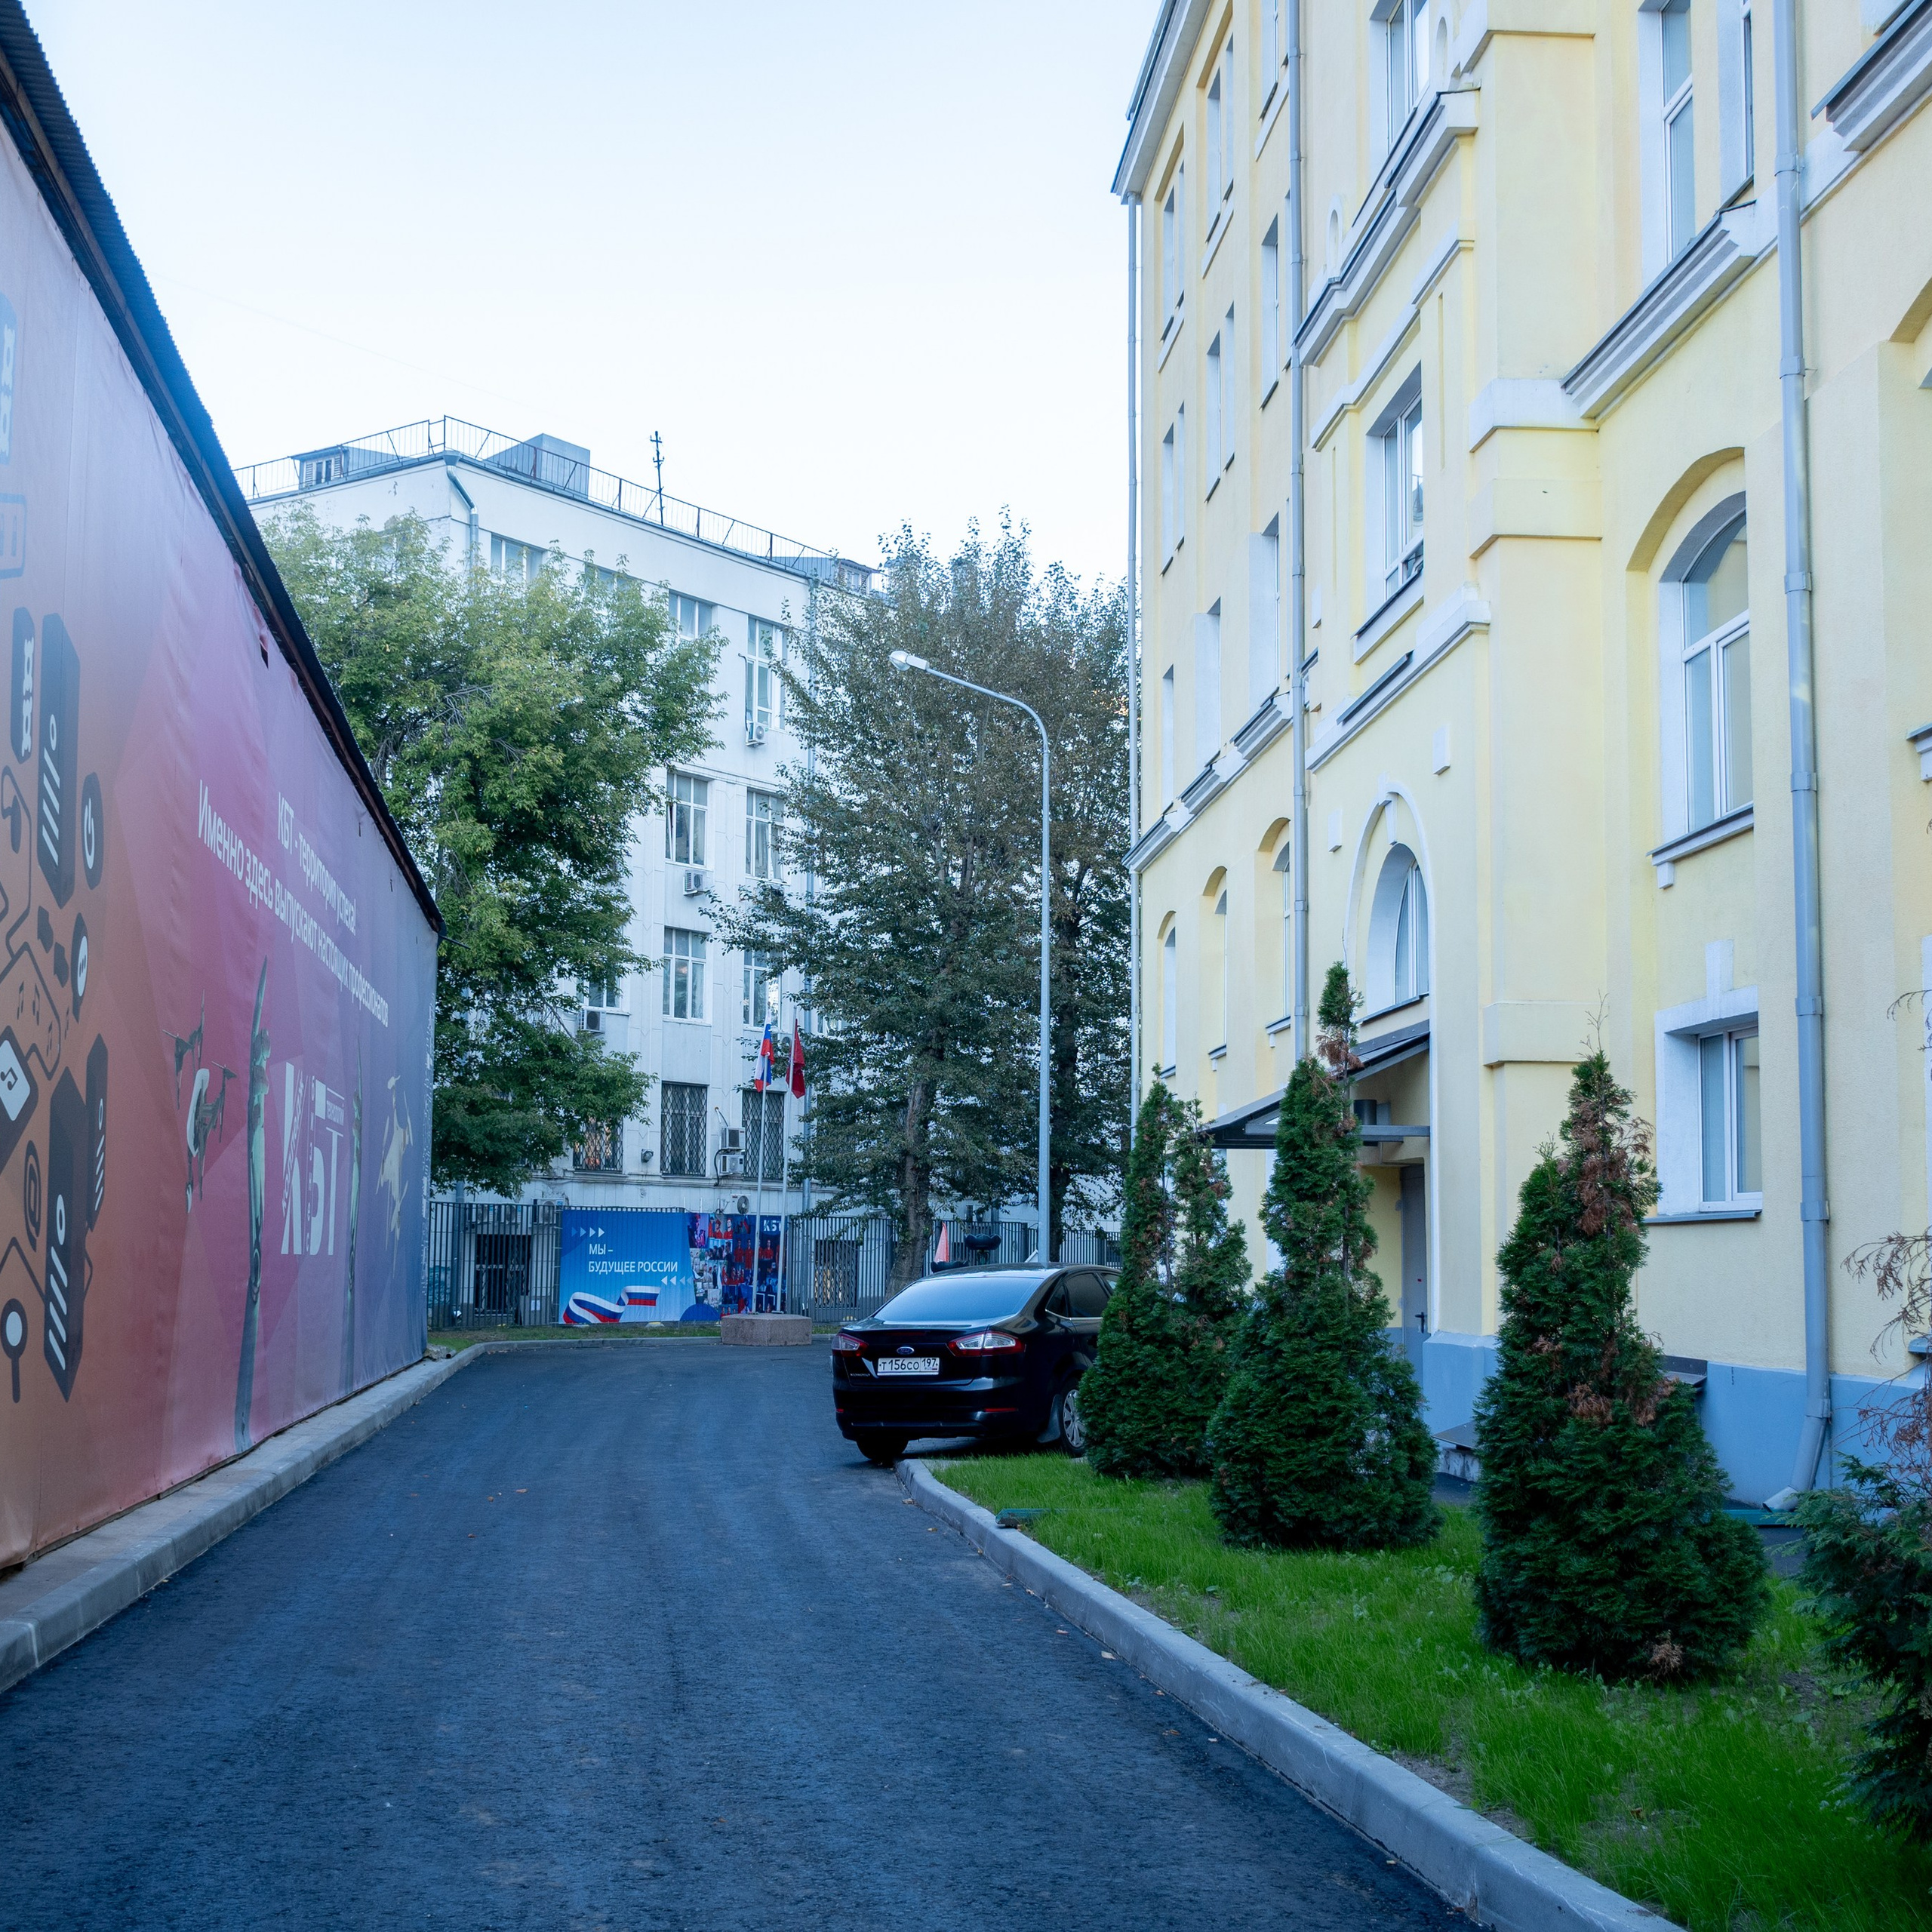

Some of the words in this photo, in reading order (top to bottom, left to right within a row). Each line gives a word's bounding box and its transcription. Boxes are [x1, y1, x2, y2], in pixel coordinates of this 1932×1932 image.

[278, 792, 294, 855] КБТ
[337, 884, 356, 936] успеха!
[198, 779, 245, 881] Именно
[245, 848, 273, 910] здесь
[275, 878, 318, 954] выпускают
[318, 925, 349, 992] настоящих
[589, 1244, 606, 1254] МЫ
[589, 1261, 635, 1275] БУДУЩЕЕ
[638, 1261, 678, 1272] РОССИИ
[921, 1358, 937, 1367] 197
